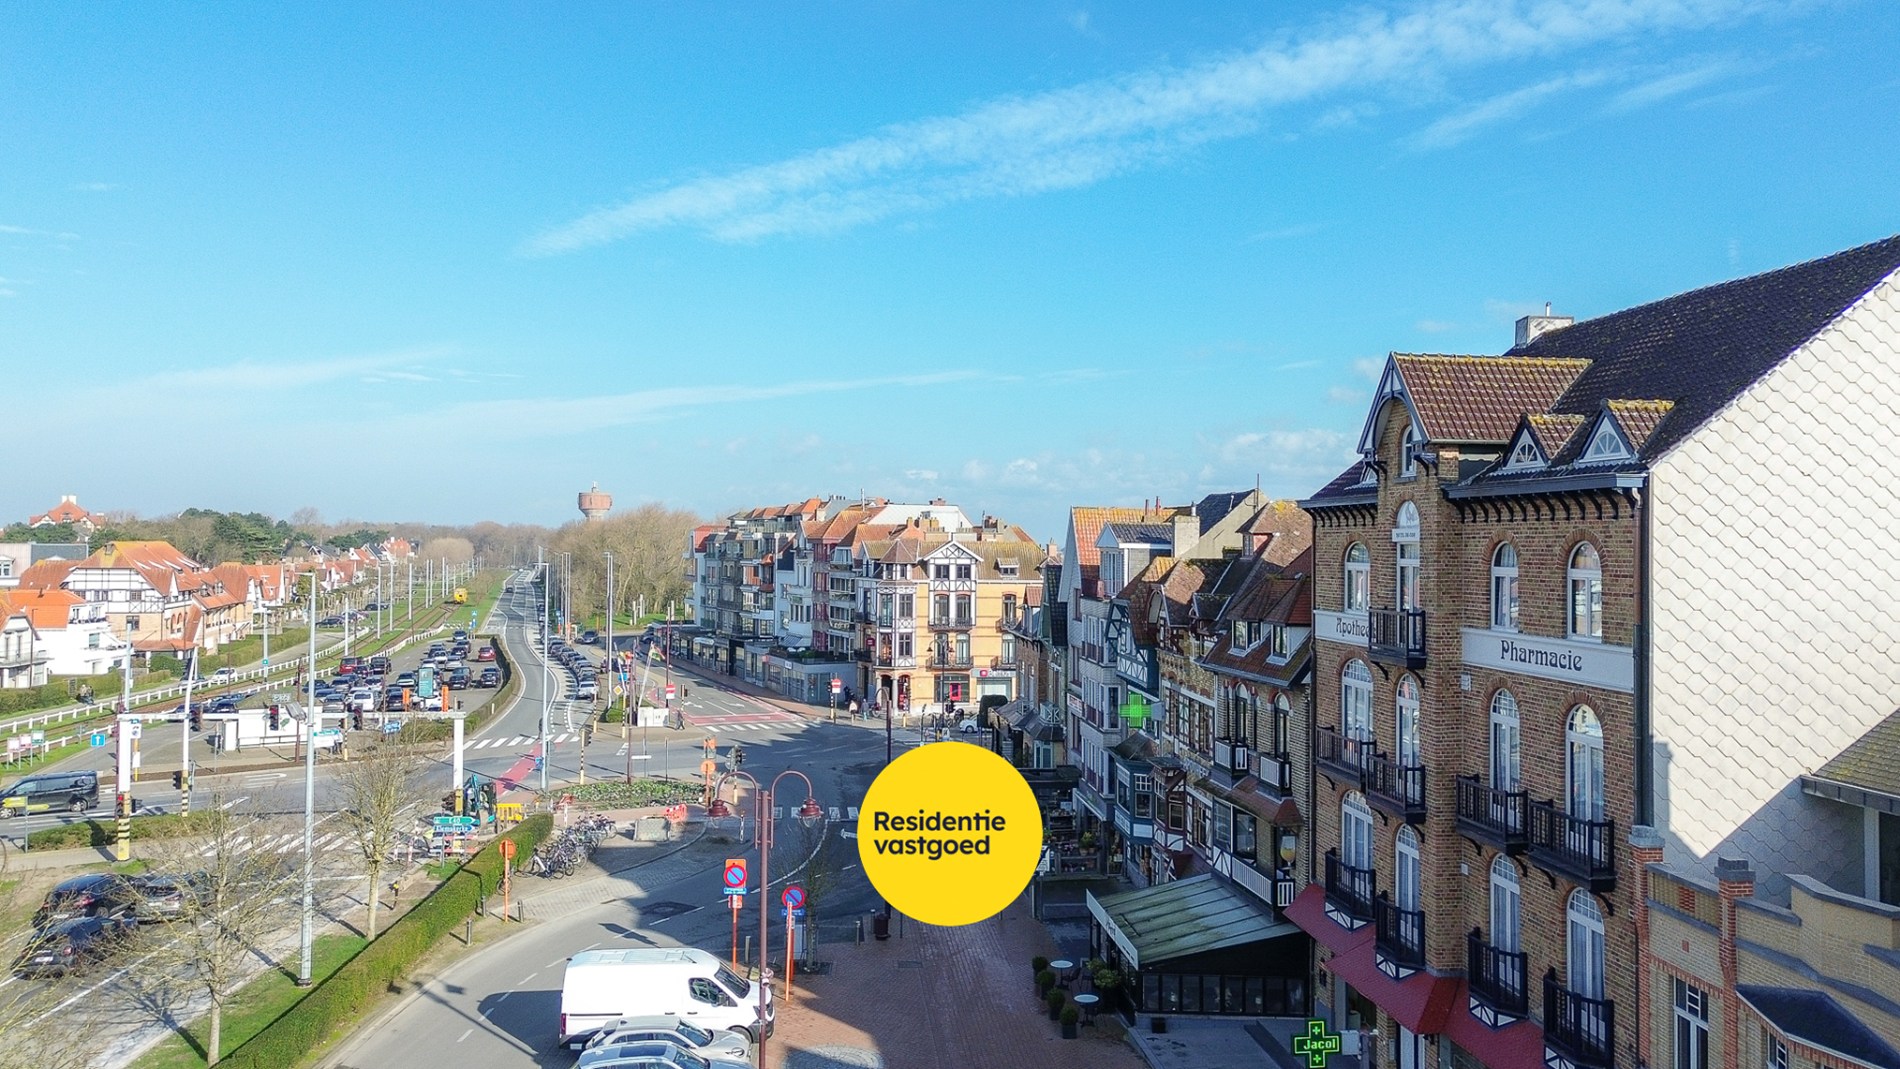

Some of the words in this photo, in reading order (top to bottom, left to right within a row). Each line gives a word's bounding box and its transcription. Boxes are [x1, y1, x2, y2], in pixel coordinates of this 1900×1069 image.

[1336, 617, 1373, 639] Apothe
[1500, 639, 1582, 672] Pharmacie
[1303, 1039, 1336, 1050] Jacol
